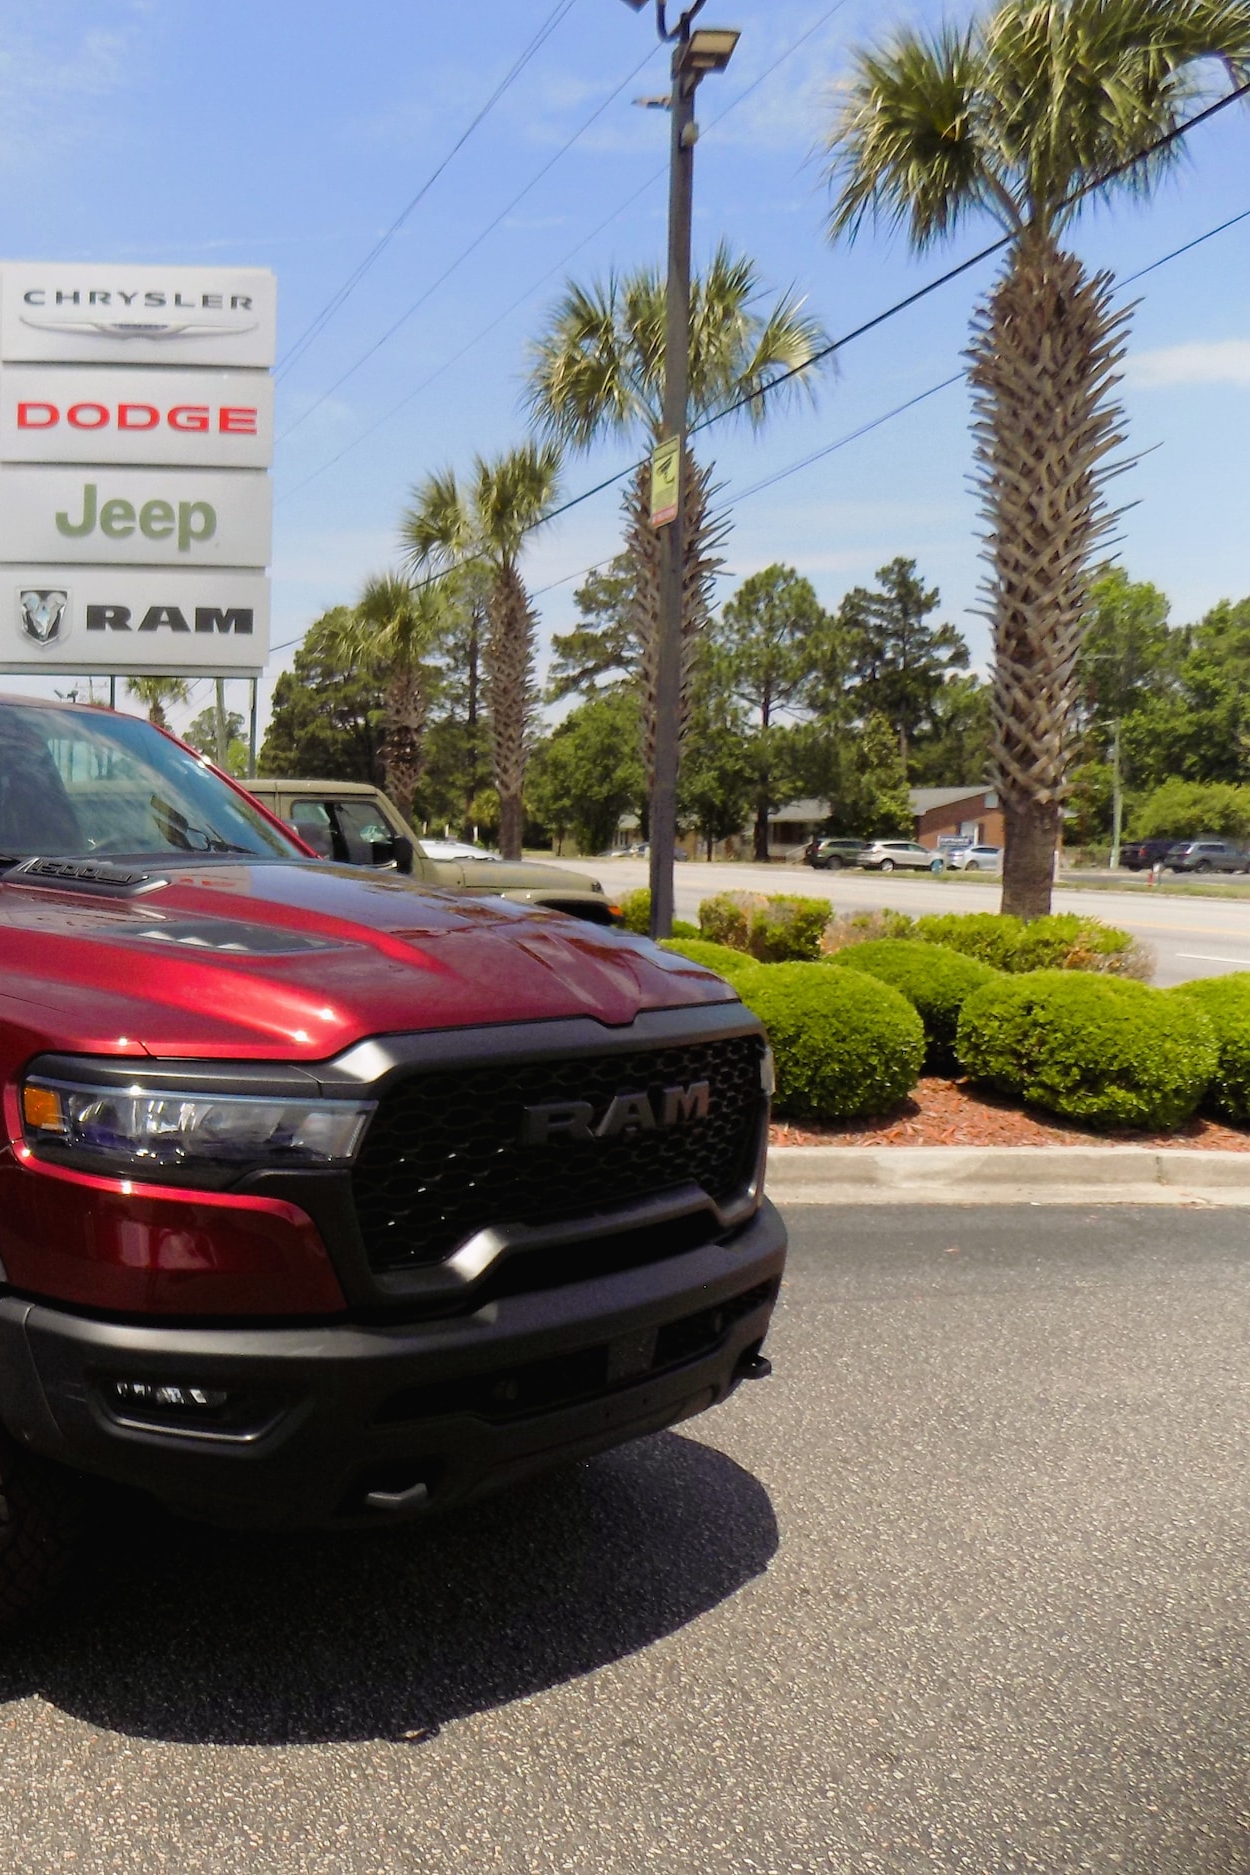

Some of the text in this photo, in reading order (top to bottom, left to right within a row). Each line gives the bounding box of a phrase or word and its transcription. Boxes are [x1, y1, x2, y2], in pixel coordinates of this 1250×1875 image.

[23, 290, 254, 311] CHRYSLER
[17, 402, 258, 434] DODGE
[55, 484, 217, 551] Jeep
[86, 605, 254, 635] RAM
[523, 1081, 710, 1145] RAM
